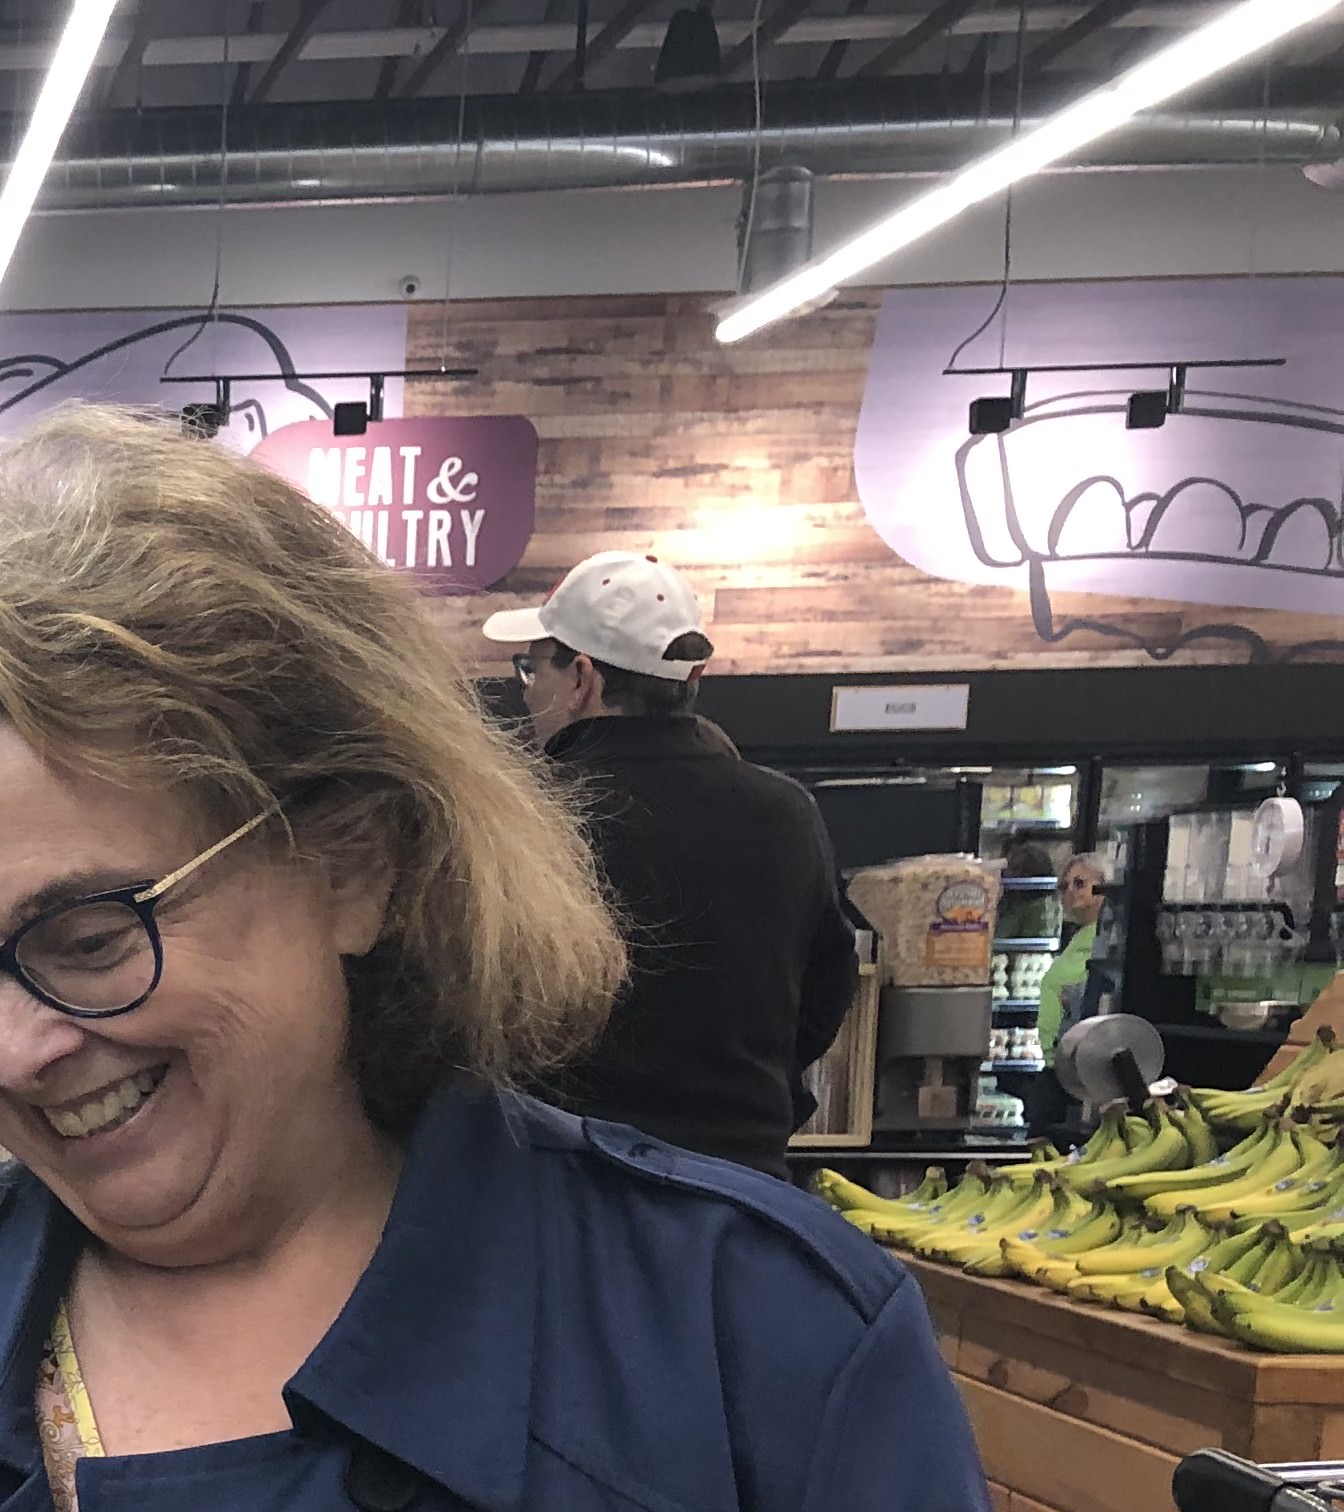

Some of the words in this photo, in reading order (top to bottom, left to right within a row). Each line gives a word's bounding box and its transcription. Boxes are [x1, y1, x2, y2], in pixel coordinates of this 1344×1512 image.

[308, 445, 421, 507] MEAT
[427, 456, 479, 504] &
[336, 509, 484, 568] ULTRY
